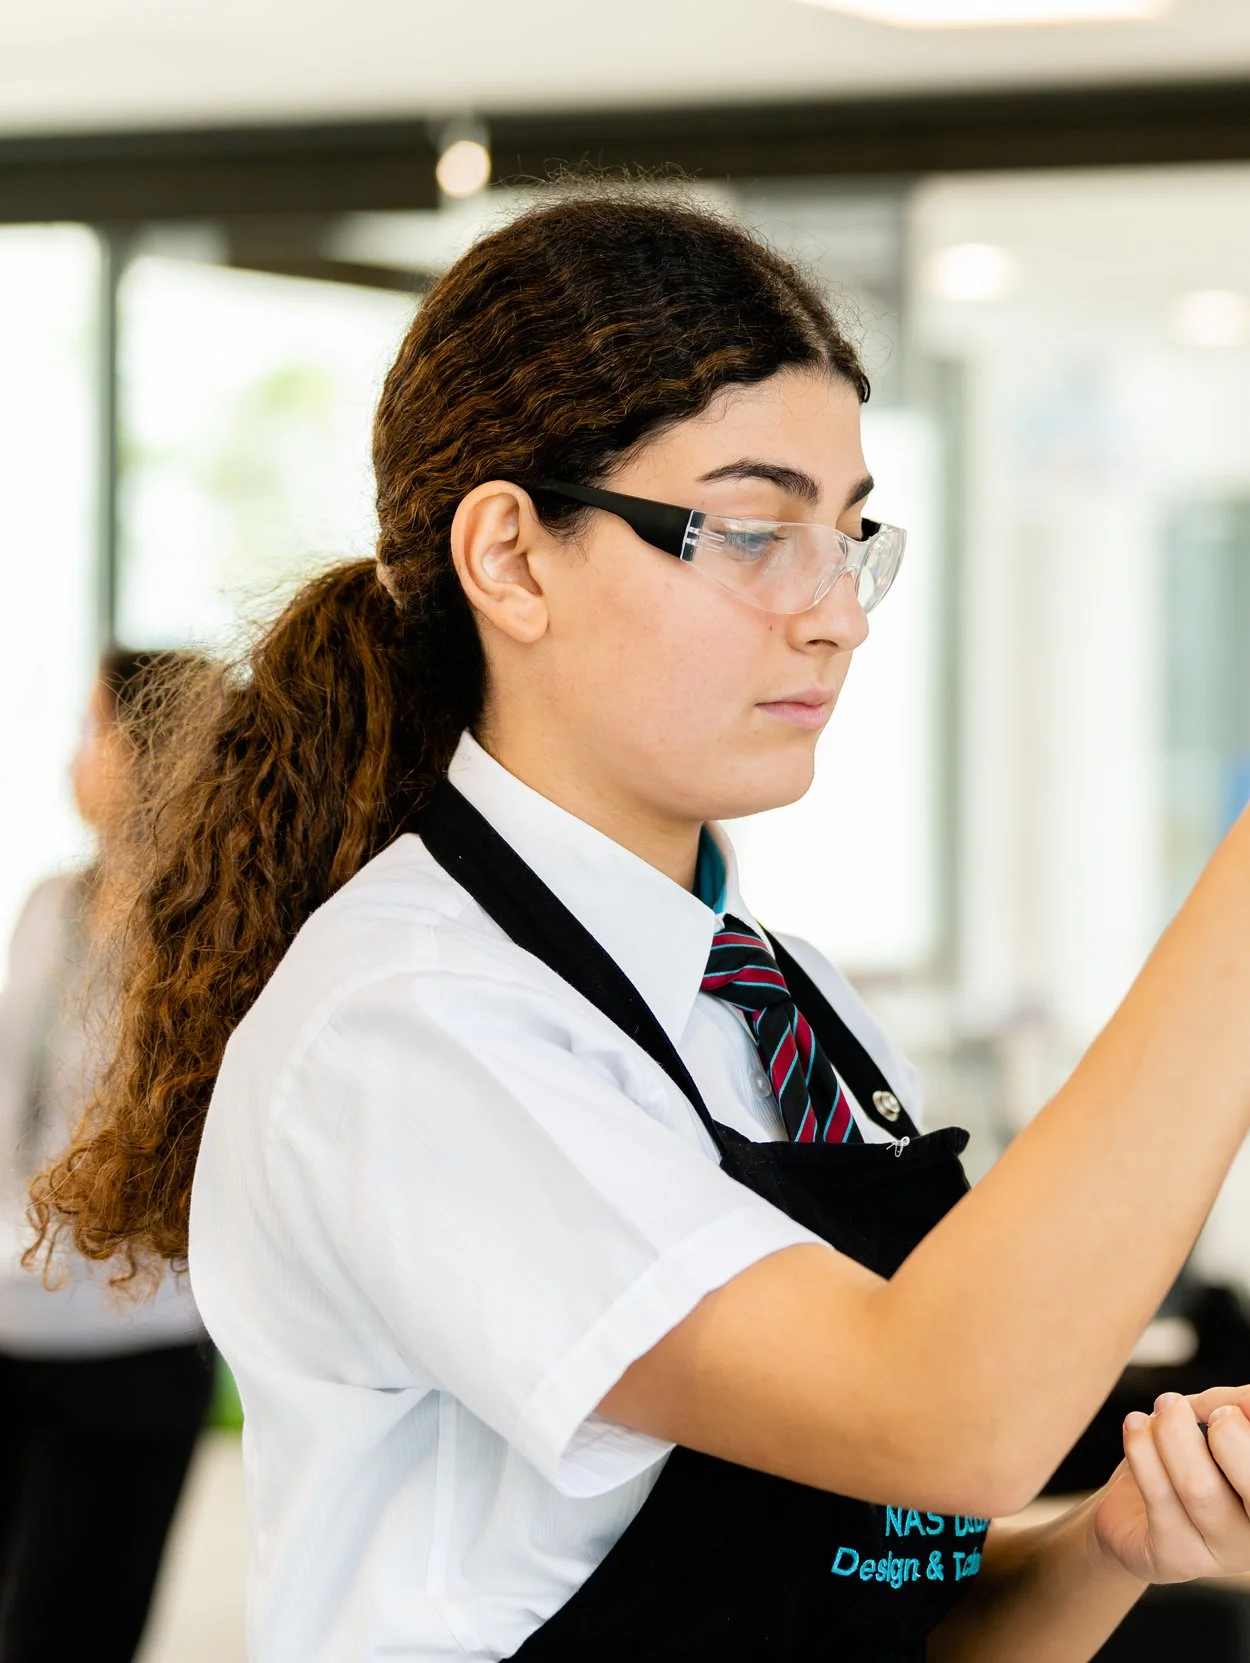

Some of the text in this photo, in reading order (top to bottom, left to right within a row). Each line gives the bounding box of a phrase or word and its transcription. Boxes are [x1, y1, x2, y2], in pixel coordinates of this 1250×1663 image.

[885, 1505, 945, 1537] NAS
[831, 1546, 921, 1589] Design
[926, 1550, 945, 1582] &
